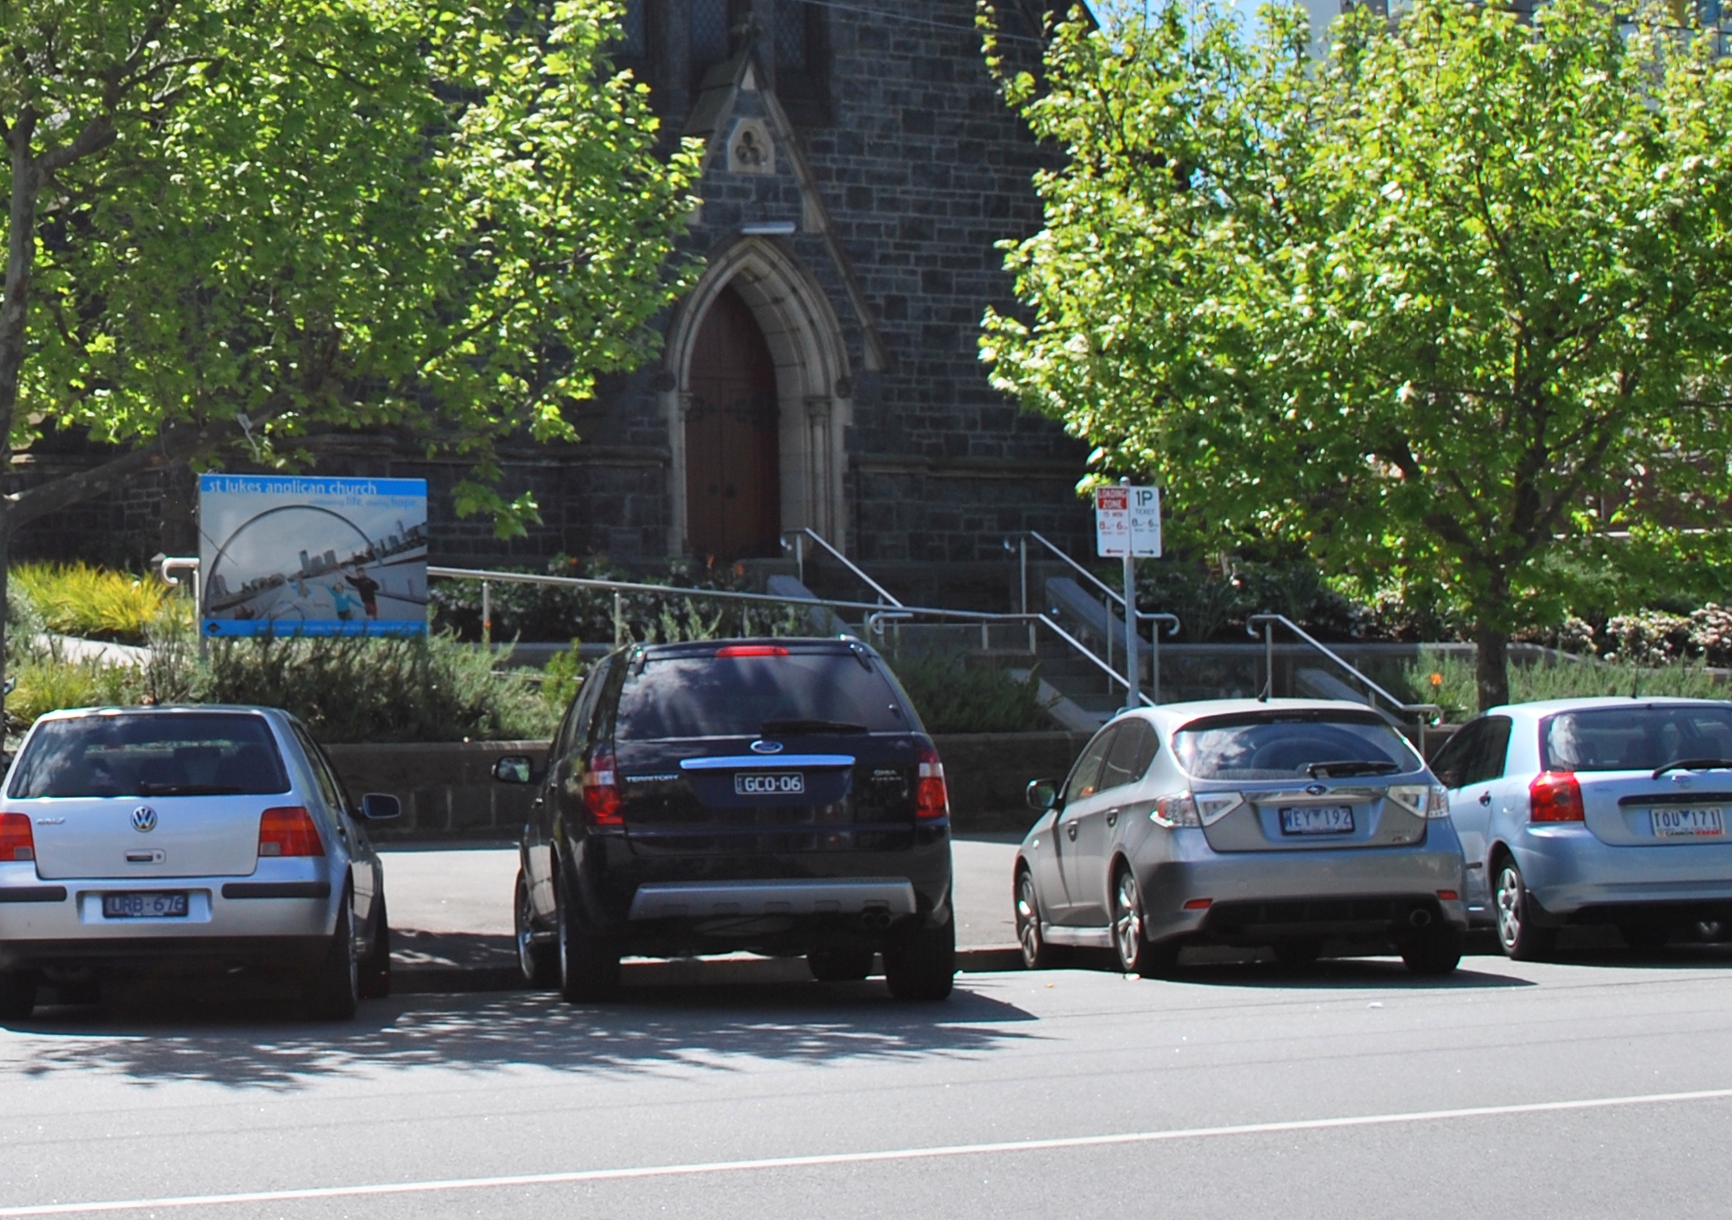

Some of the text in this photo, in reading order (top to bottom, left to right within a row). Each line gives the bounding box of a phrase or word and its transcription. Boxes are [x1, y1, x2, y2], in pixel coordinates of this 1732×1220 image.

[209, 479, 377, 496] st lukes anglican church
[1099, 488, 1127, 498] LOADING
[1102, 499, 1122, 509] ZONE
[1136, 490, 1153, 506] 1P
